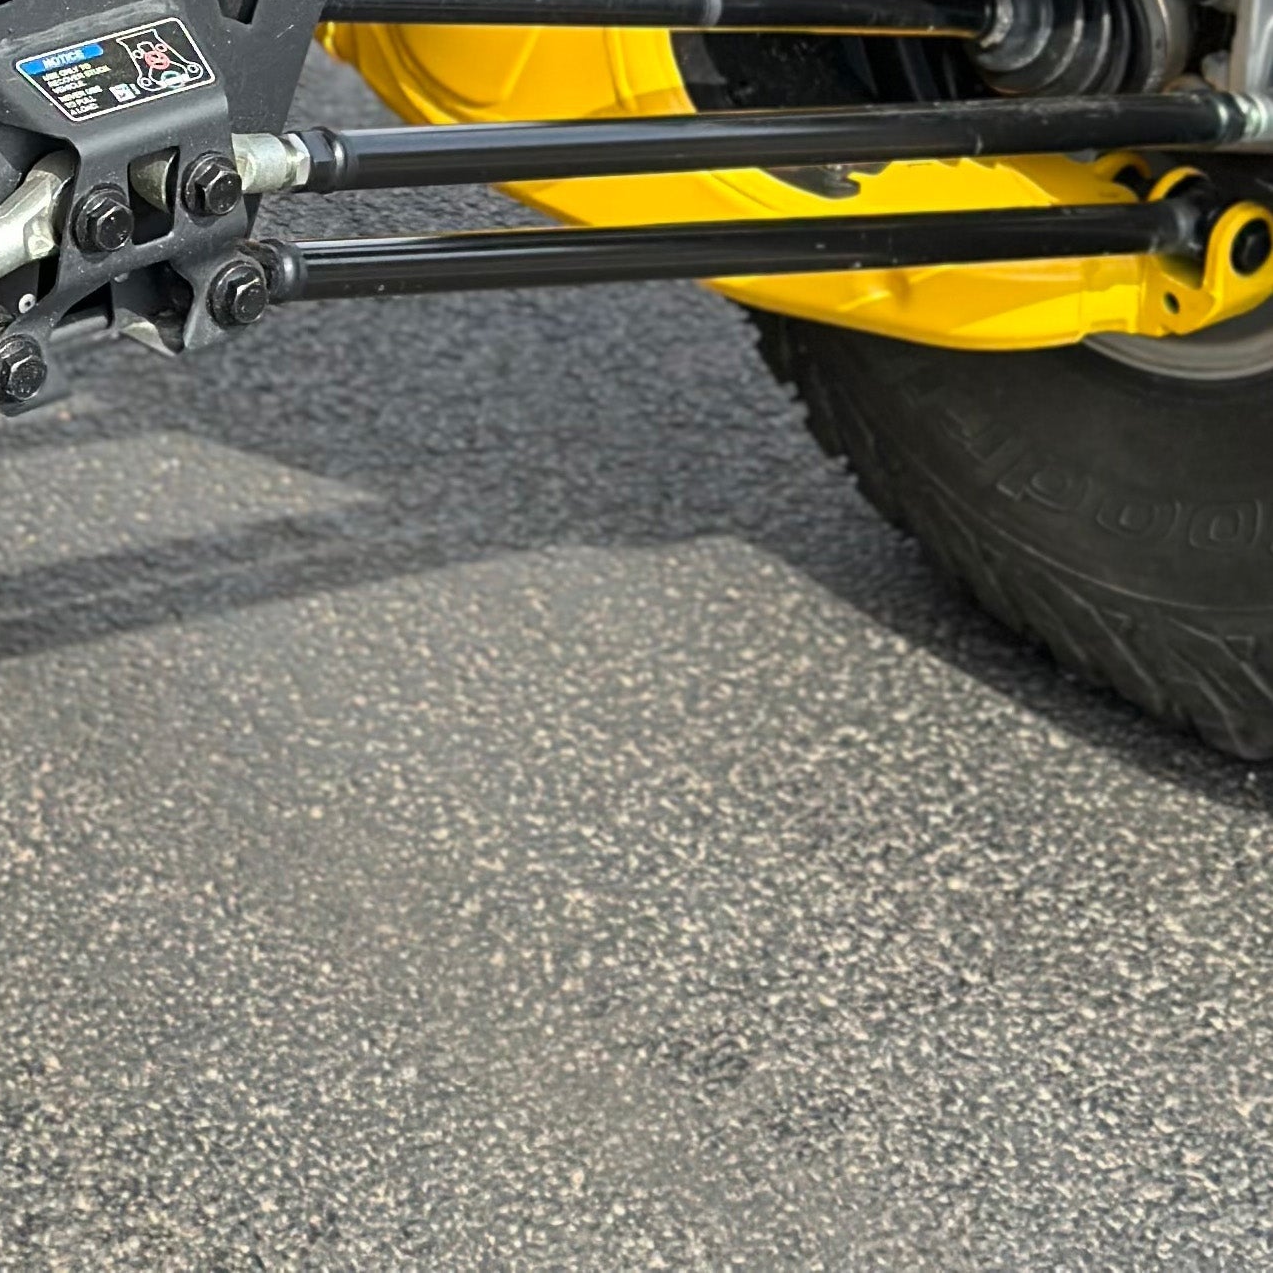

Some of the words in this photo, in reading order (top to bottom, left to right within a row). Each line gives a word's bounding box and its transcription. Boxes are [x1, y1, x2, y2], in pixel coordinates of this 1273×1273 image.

[42, 49, 85, 70] NOTICE
[47, 72, 85, 87] RECOVER
[83, 64, 111, 77] STUCK
[58, 66, 78, 76] ONLY
[78, 63, 91, 71] TO
[58, 90, 86, 102] NEVER
[75, 96, 97, 106] PULL
